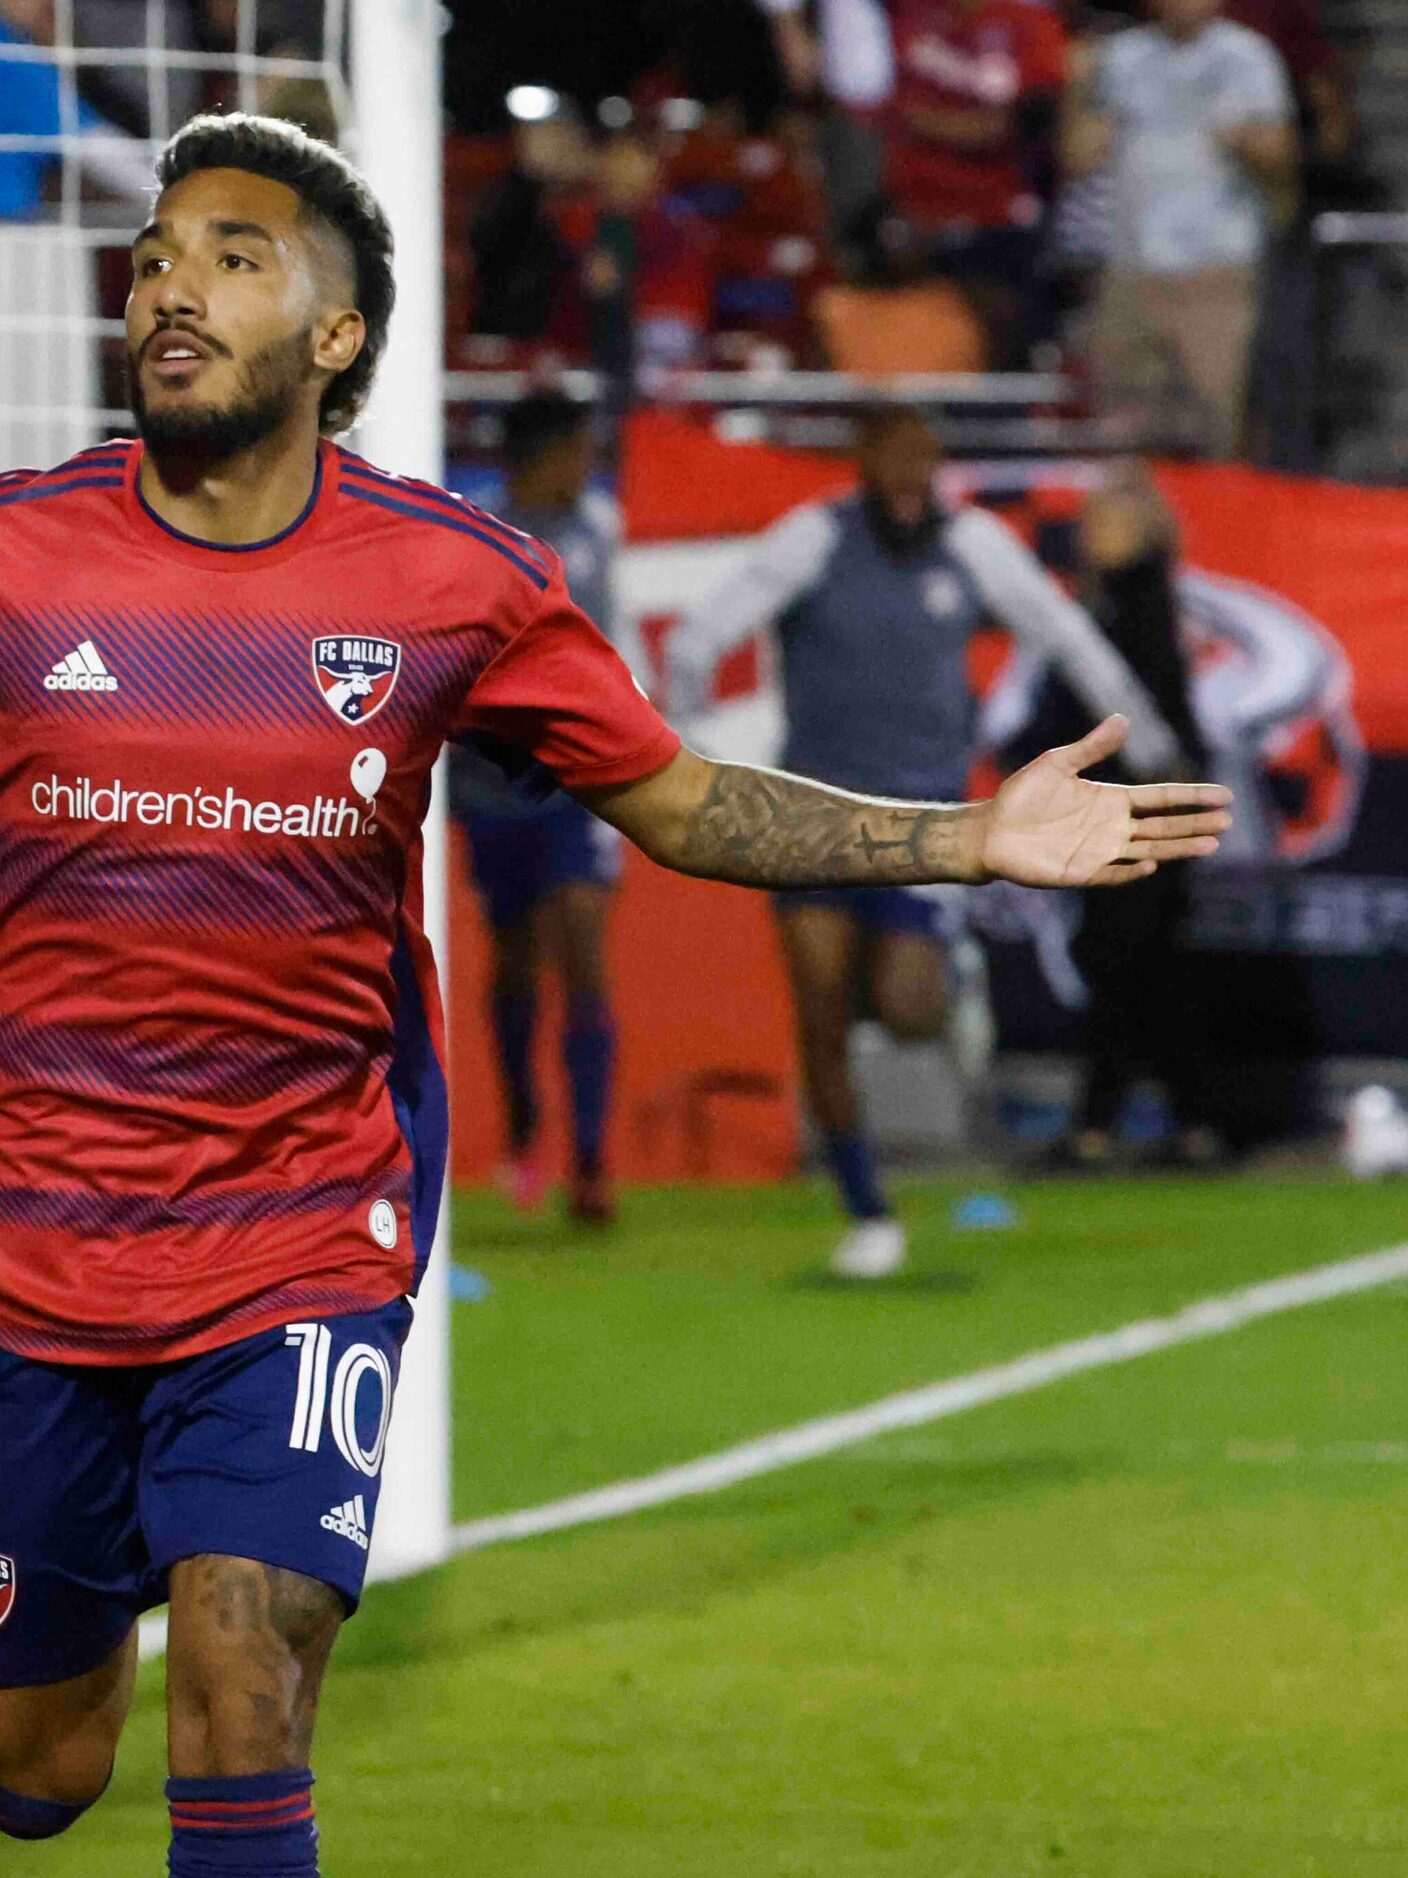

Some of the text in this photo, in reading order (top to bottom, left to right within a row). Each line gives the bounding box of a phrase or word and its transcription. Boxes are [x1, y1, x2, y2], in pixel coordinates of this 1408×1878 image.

[319, 640, 393, 667] FC DALLAS
[43, 671, 119, 692] adidas
[284, 1323, 392, 1478] 10
